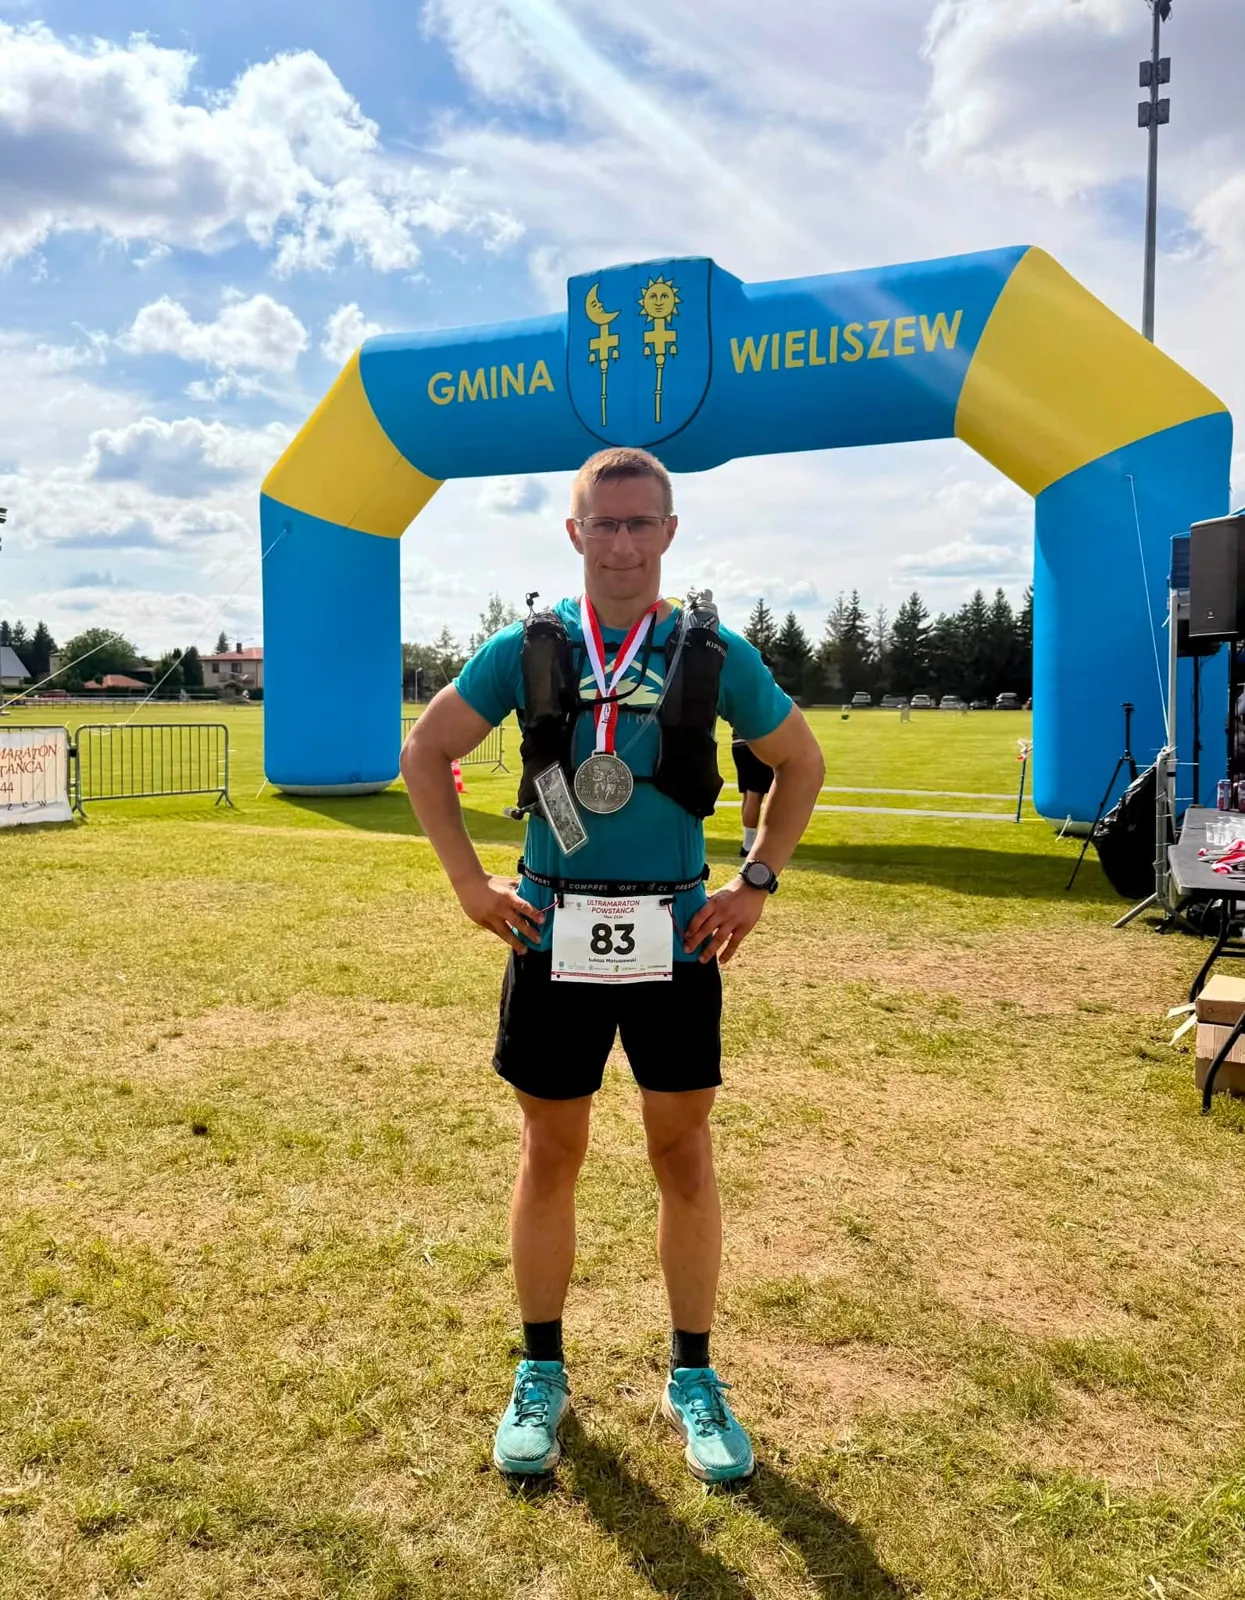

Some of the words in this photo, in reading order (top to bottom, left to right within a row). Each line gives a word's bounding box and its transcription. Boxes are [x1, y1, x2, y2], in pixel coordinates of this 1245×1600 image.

[428, 359, 555, 406] GMINA
[730, 309, 964, 375] WIELISZEW
[587, 899, 640, 907] ULTRAMARATON
[590, 923, 636, 955] 83
